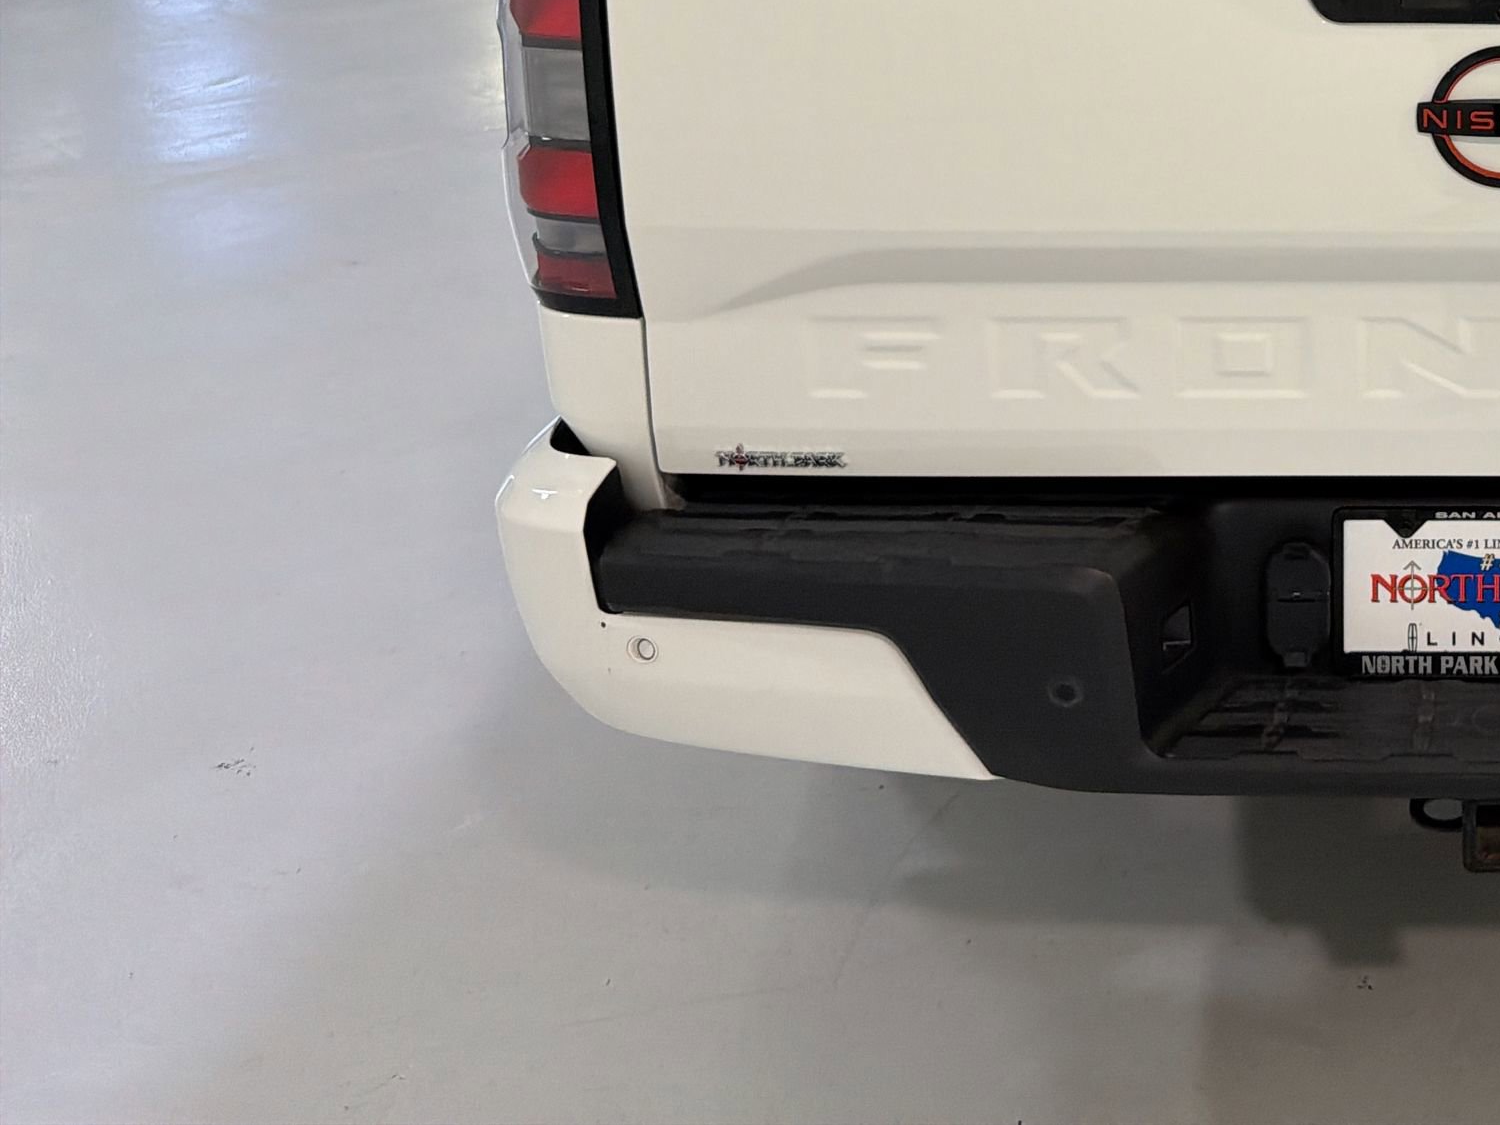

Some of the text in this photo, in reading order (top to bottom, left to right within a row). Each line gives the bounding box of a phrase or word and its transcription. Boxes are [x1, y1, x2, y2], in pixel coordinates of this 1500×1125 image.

[1435, 511, 1476, 519] SAN
[1393, 538, 1463, 550] AMERICA'S
[1467, 539, 1480, 550] #1
[1361, 656, 1432, 675] NORTH
[1440, 656, 1499, 675] PARK
